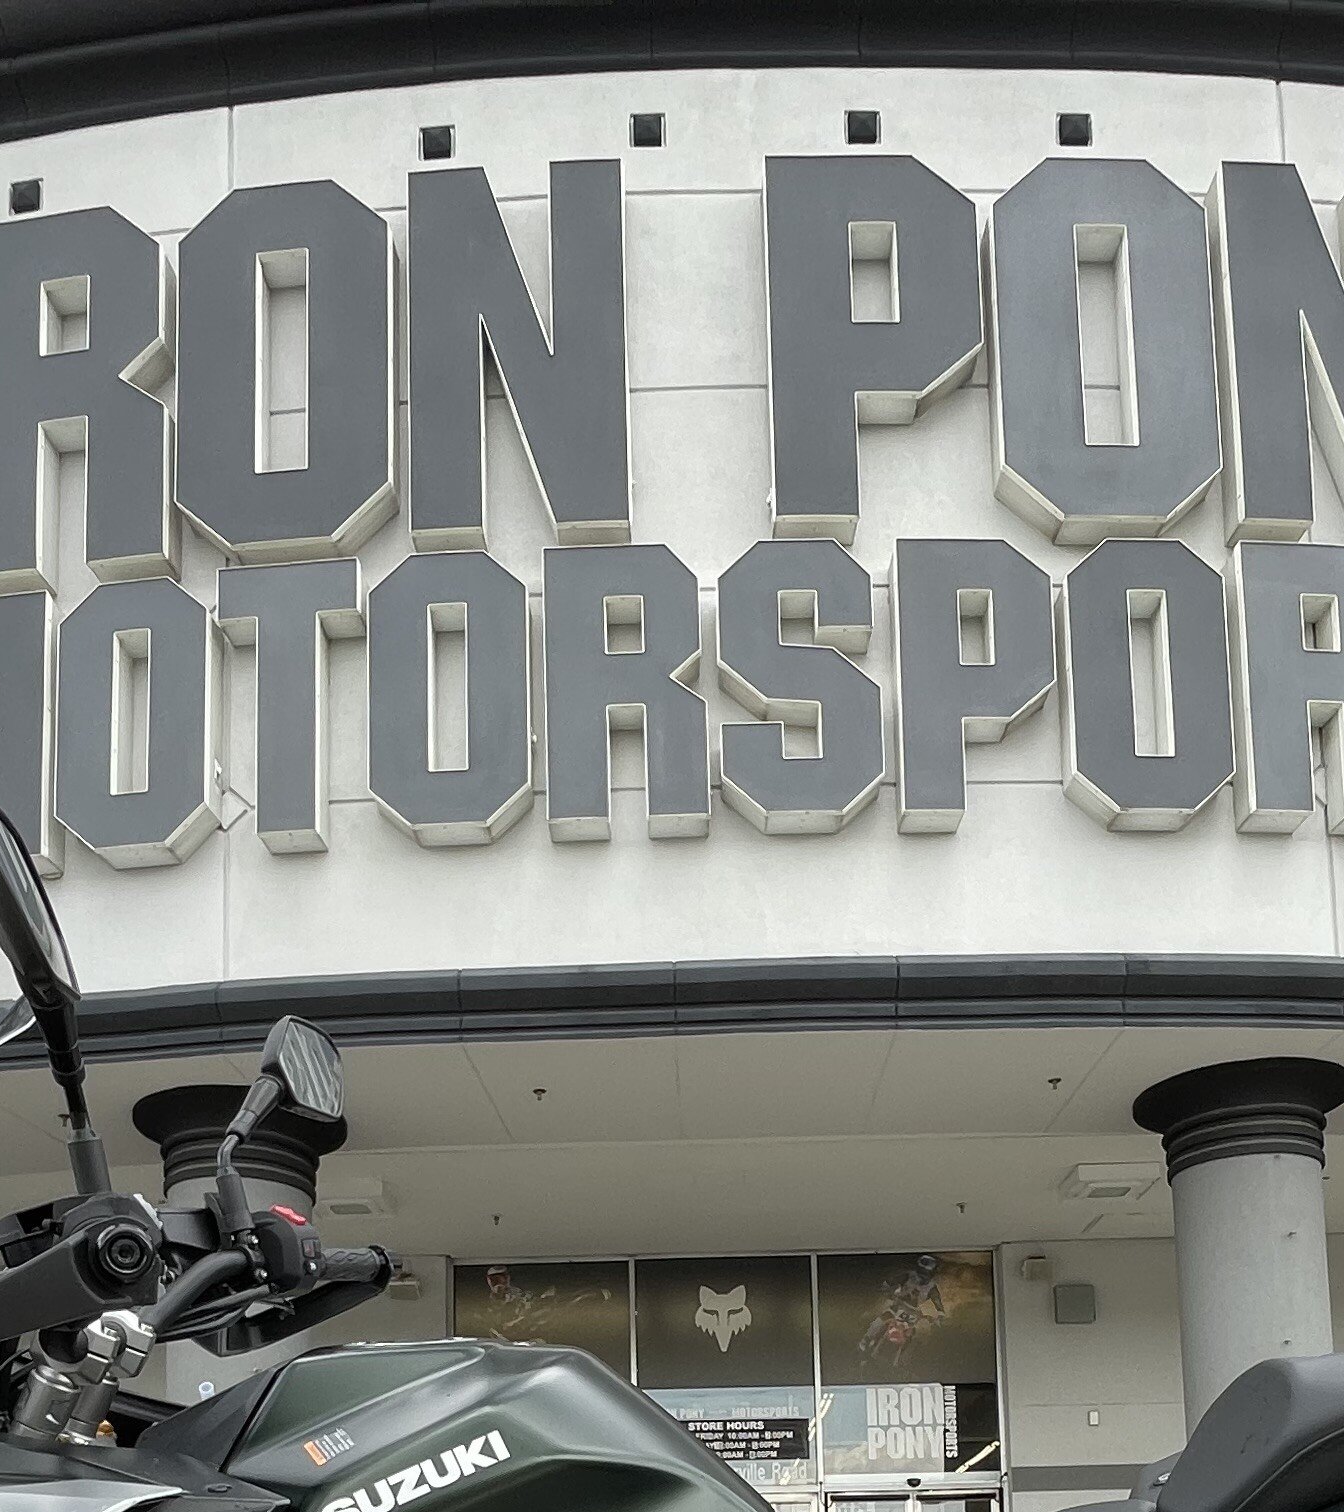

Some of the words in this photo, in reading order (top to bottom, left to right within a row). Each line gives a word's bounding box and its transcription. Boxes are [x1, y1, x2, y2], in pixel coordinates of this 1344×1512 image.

[865, 1385, 945, 1426] IRON
[943, 1385, 959, 1459] MOTORSPORTS
[687, 1421, 724, 1431] STORE
[726, 1420, 765, 1430] HOURS
[867, 1425, 945, 1460] PONY
